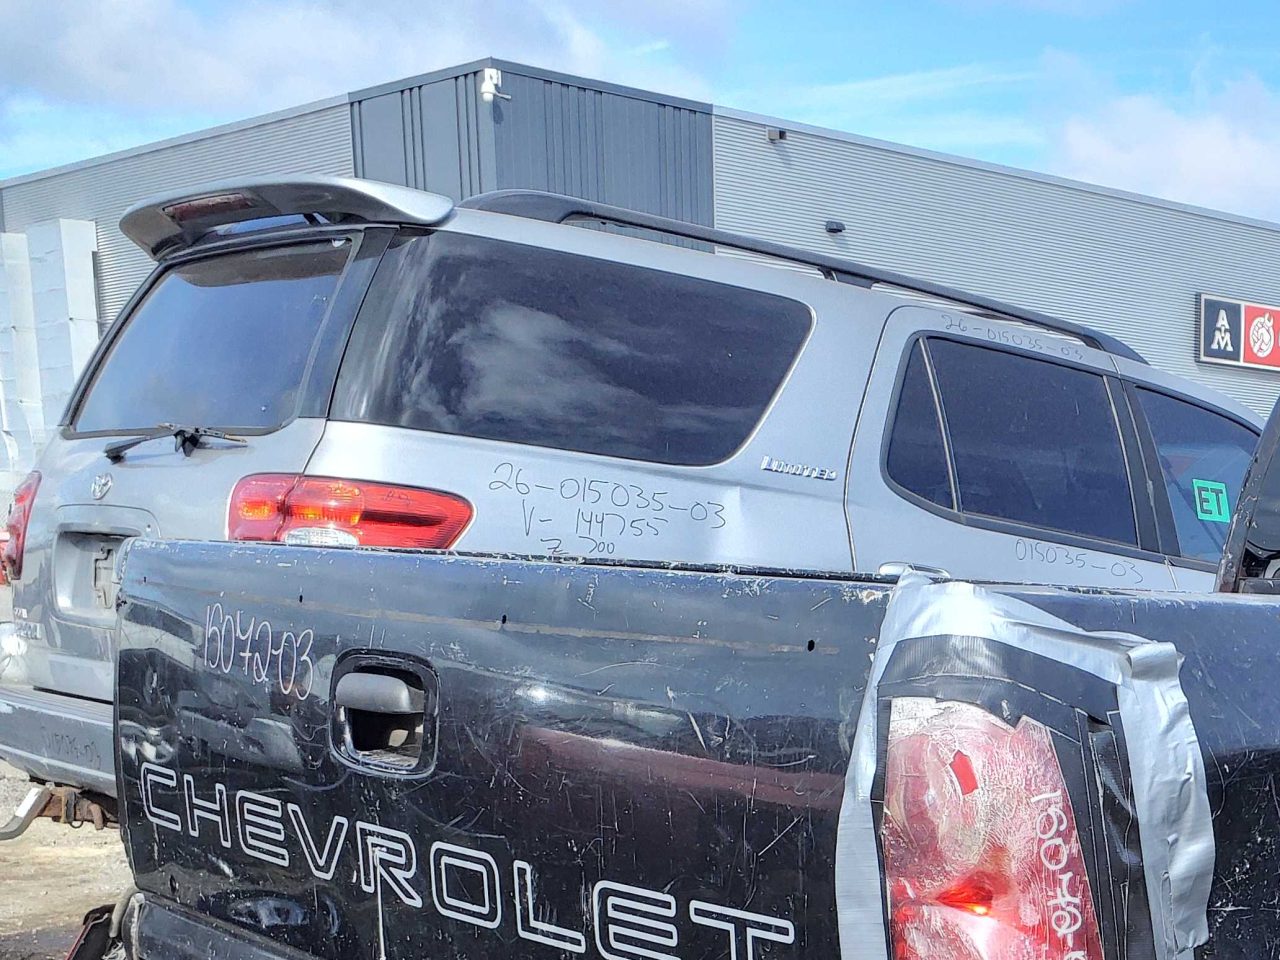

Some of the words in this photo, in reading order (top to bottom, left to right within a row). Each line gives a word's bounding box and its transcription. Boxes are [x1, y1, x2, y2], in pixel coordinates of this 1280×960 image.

[488, 462, 726, 528] 26-015035-03
[1196, 486, 1224, 516] ET
[576, 508, 669, 537] 144755
[1015, 538, 1144, 584] 015035-03
